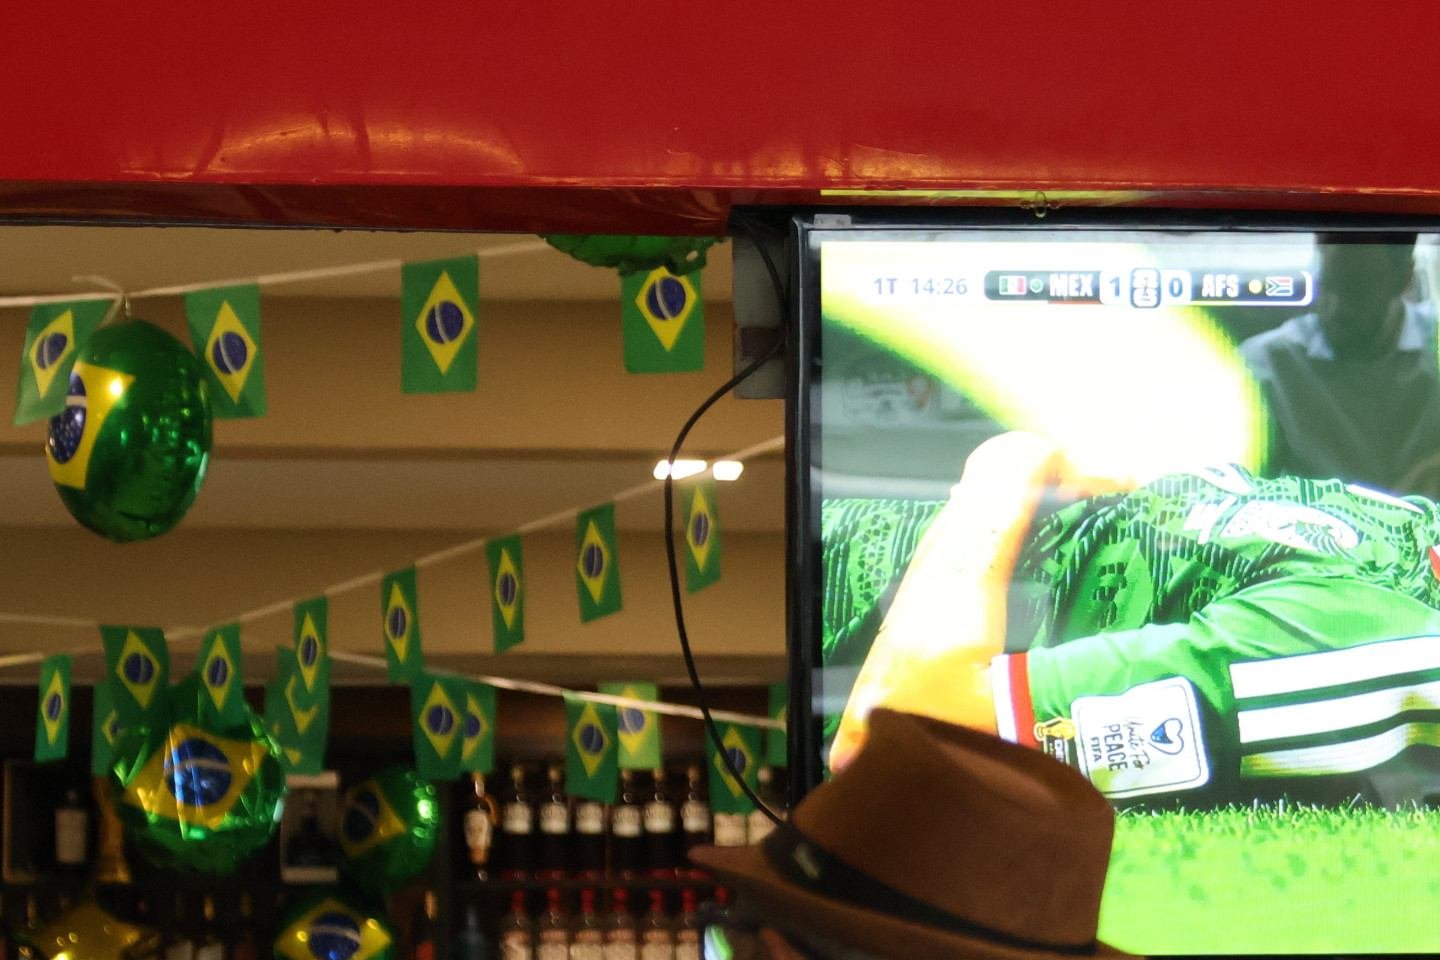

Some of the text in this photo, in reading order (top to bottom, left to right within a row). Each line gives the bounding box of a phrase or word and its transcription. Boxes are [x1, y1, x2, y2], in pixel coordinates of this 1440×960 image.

[873, 277, 898, 296] 1T
[911, 277, 968, 295] 14:26
[1049, 273, 1094, 298] MEX
[1108, 277, 1121, 297] 1
[1168, 277, 1183, 298] 0
[1201, 274, 1239, 298] AFS
[1091, 736, 1102, 763] FIFA
[1102, 724, 1128, 771] PEACE
